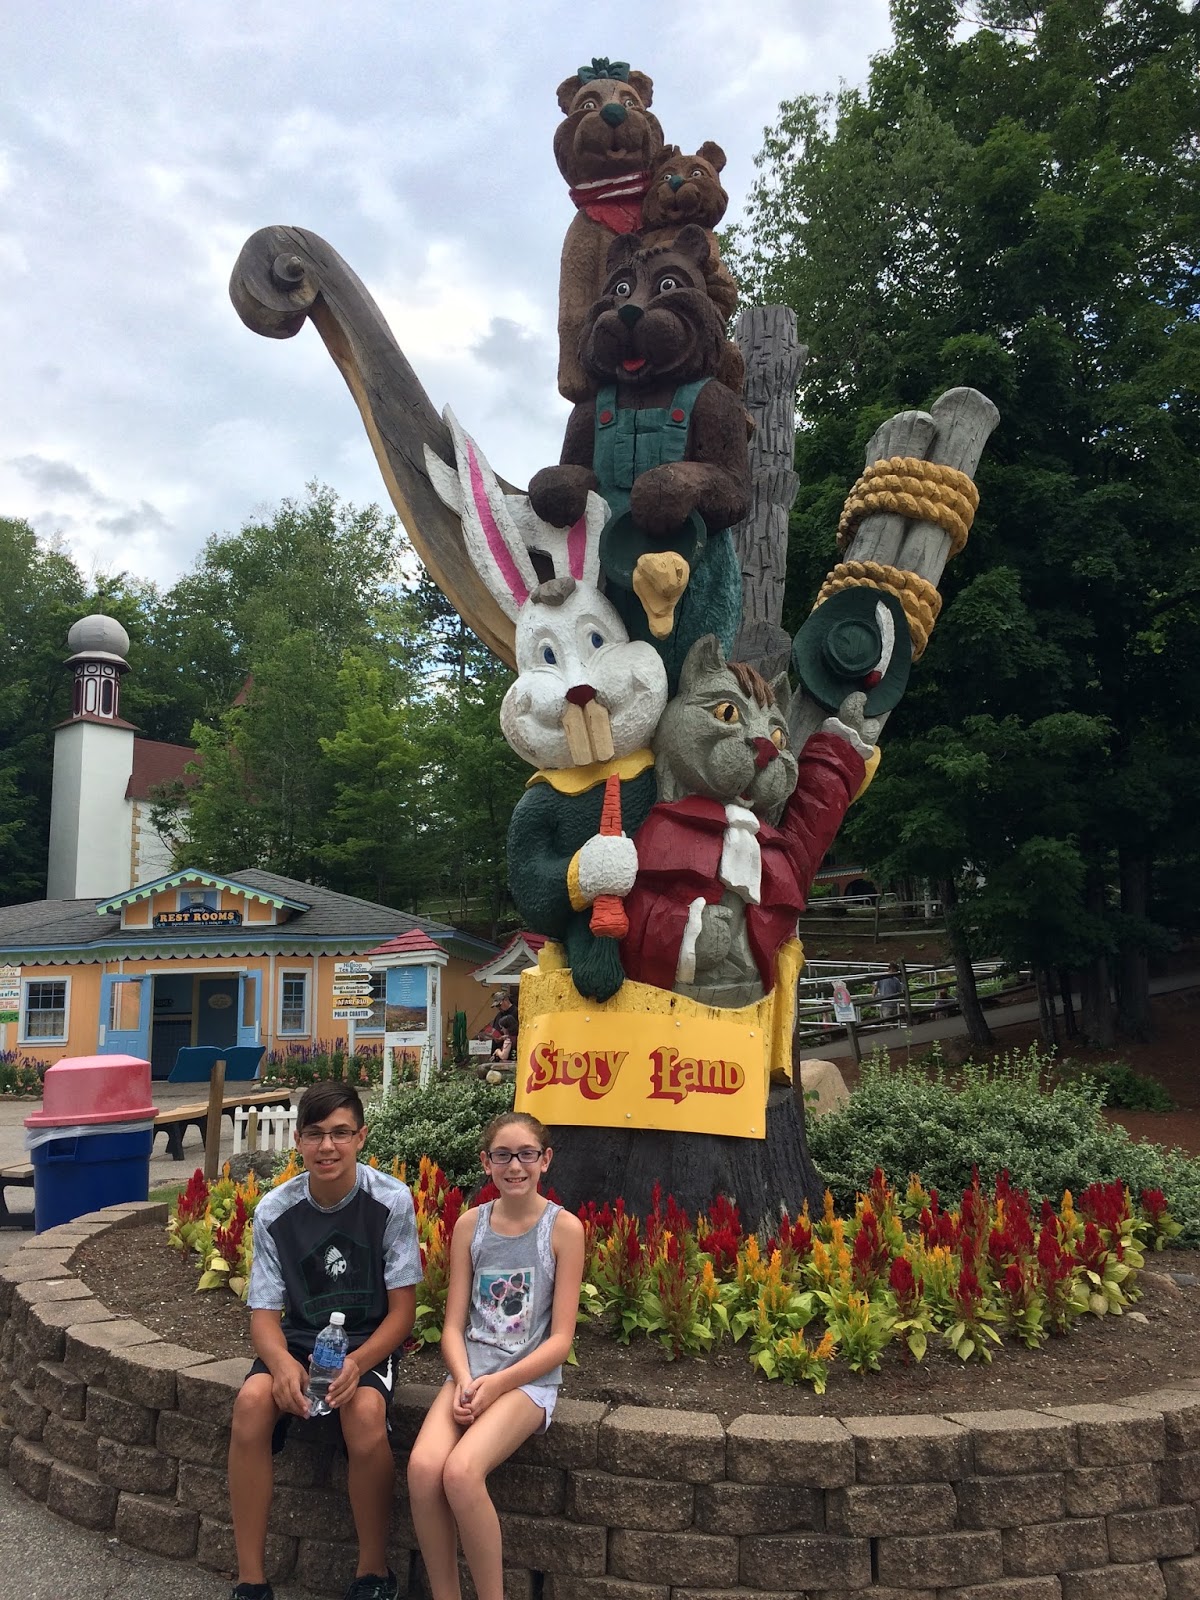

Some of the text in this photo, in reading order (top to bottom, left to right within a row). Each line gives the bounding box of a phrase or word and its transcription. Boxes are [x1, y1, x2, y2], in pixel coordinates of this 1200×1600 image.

[159, 912, 235, 923] REST ROOMS
[335, 998, 354, 1006] SAFARI
[525, 1040, 630, 1100] Story
